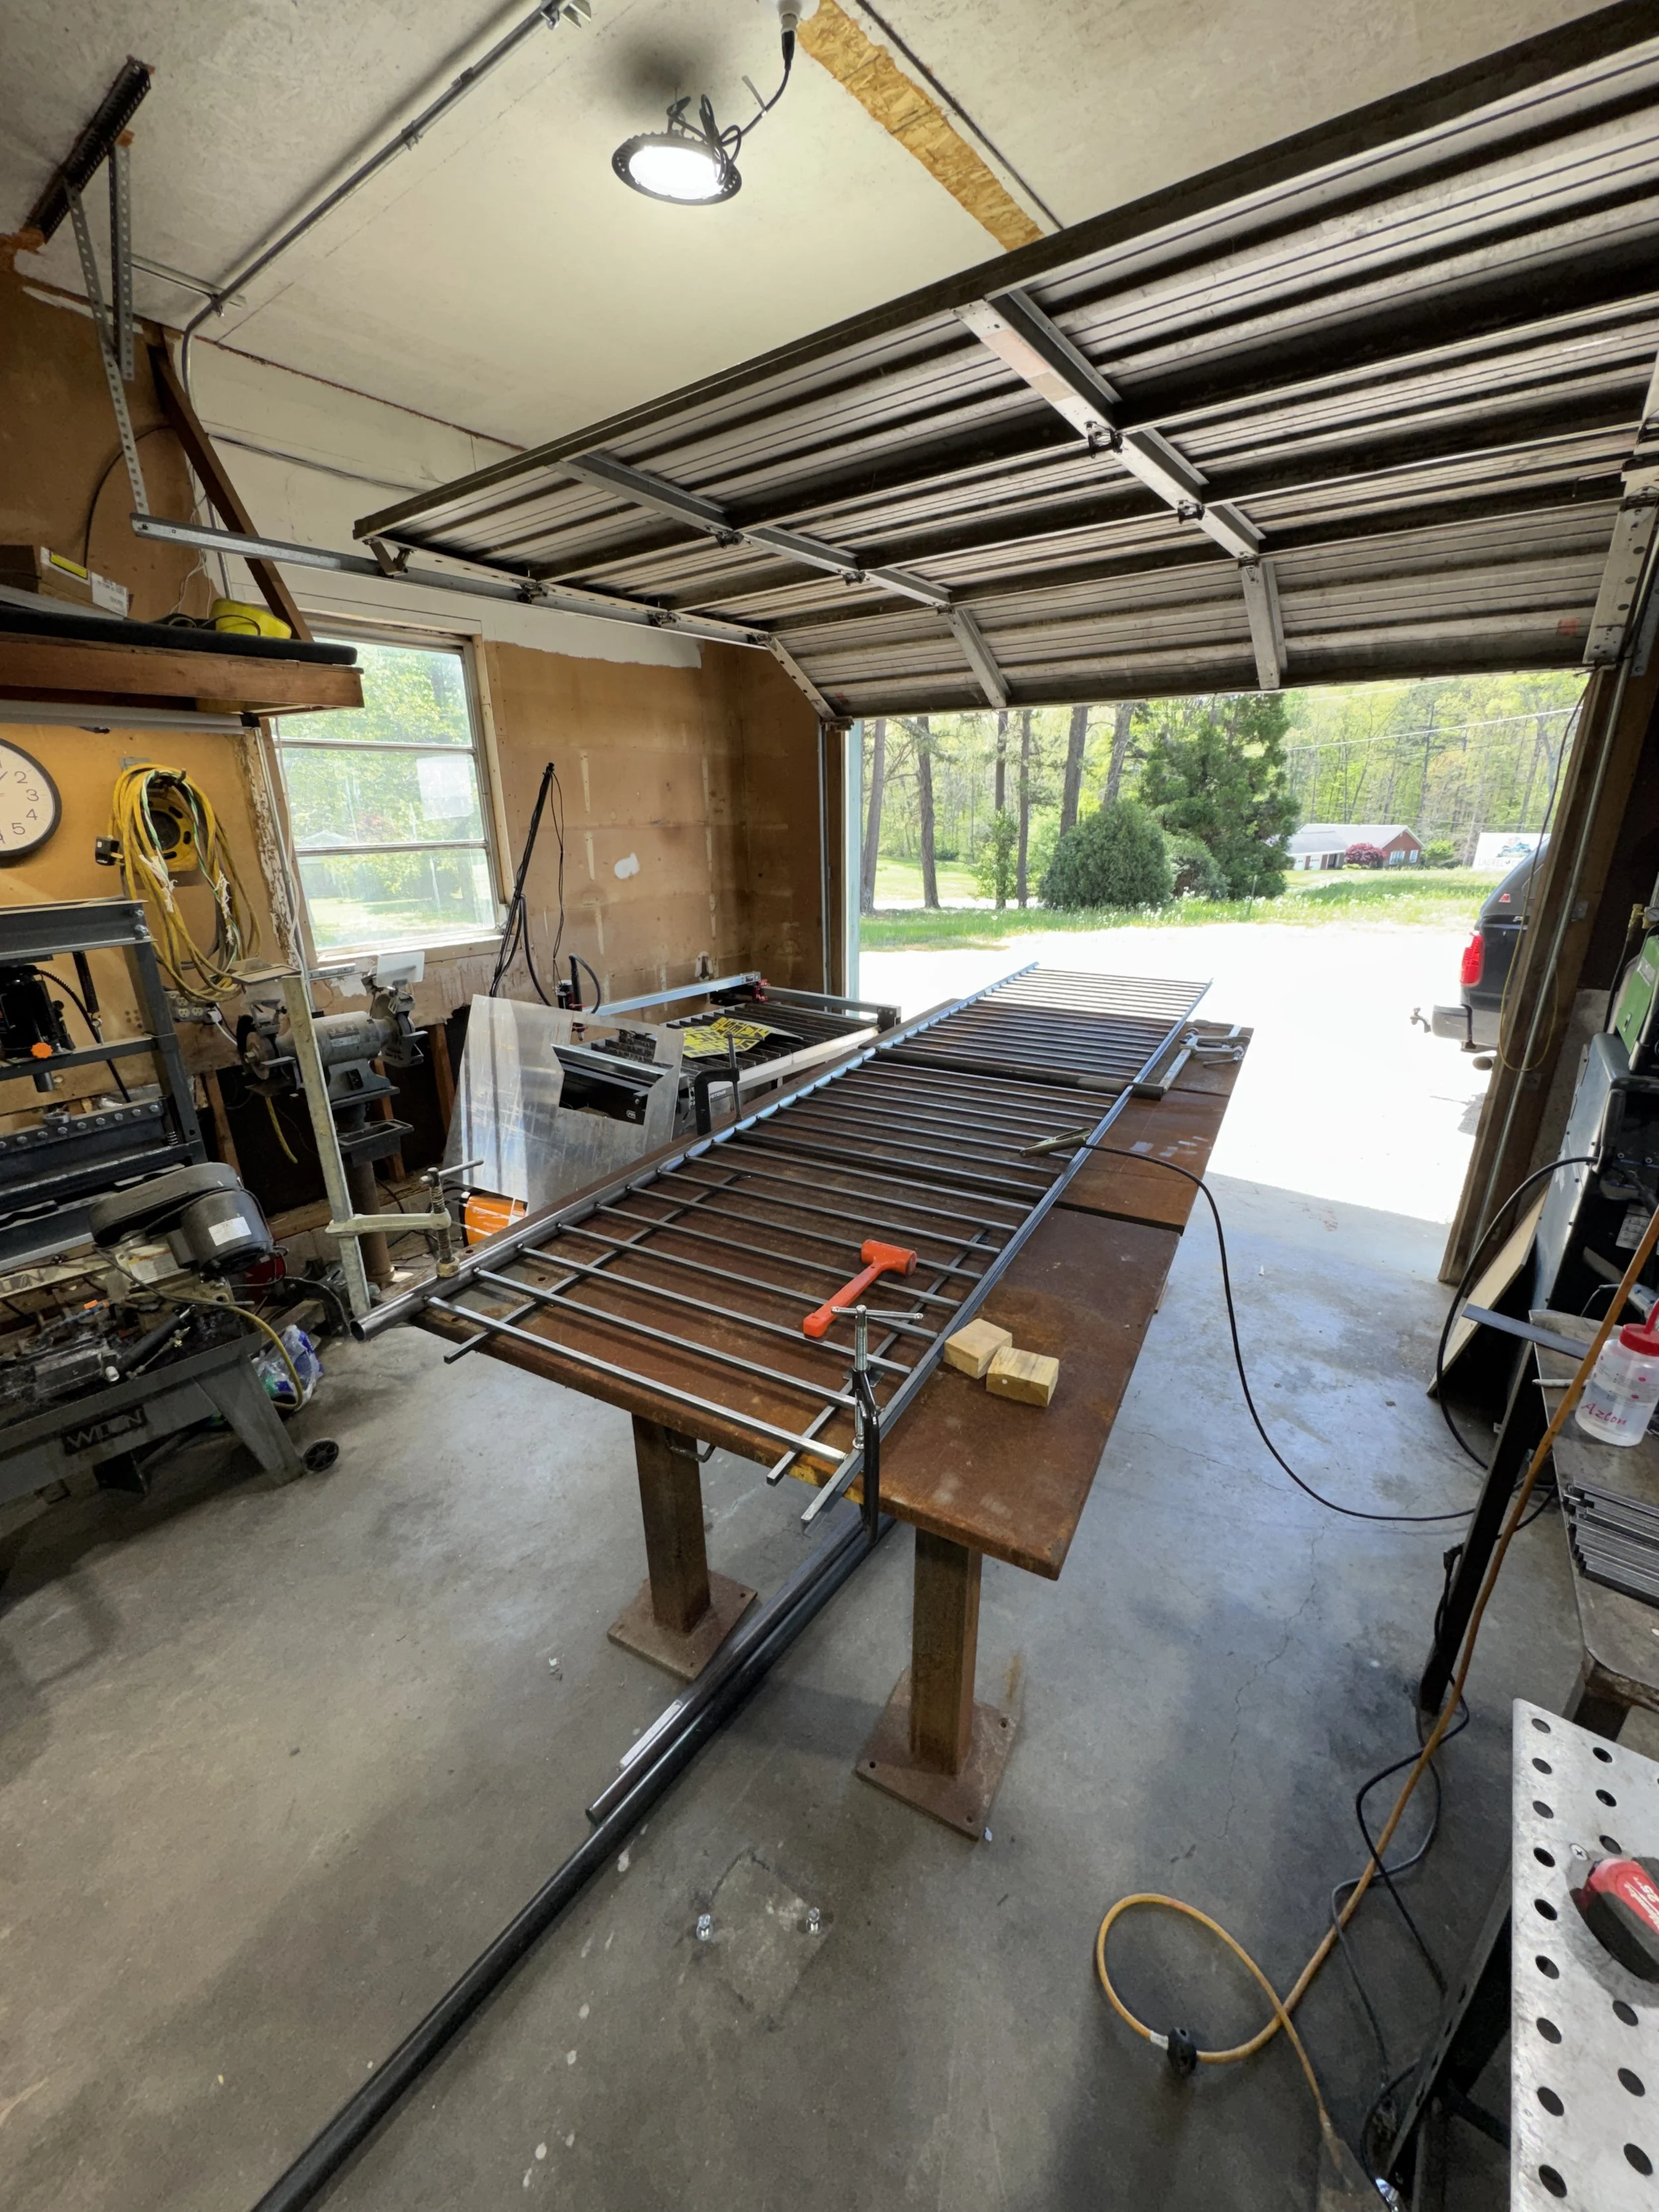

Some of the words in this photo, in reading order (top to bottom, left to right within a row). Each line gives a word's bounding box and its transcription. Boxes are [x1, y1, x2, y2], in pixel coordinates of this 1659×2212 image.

[14, 771, 29, 784] 2
[26, 788, 40, 802] 3
[25, 808, 38, 821] 4
[11, 822, 26, 836] 5
